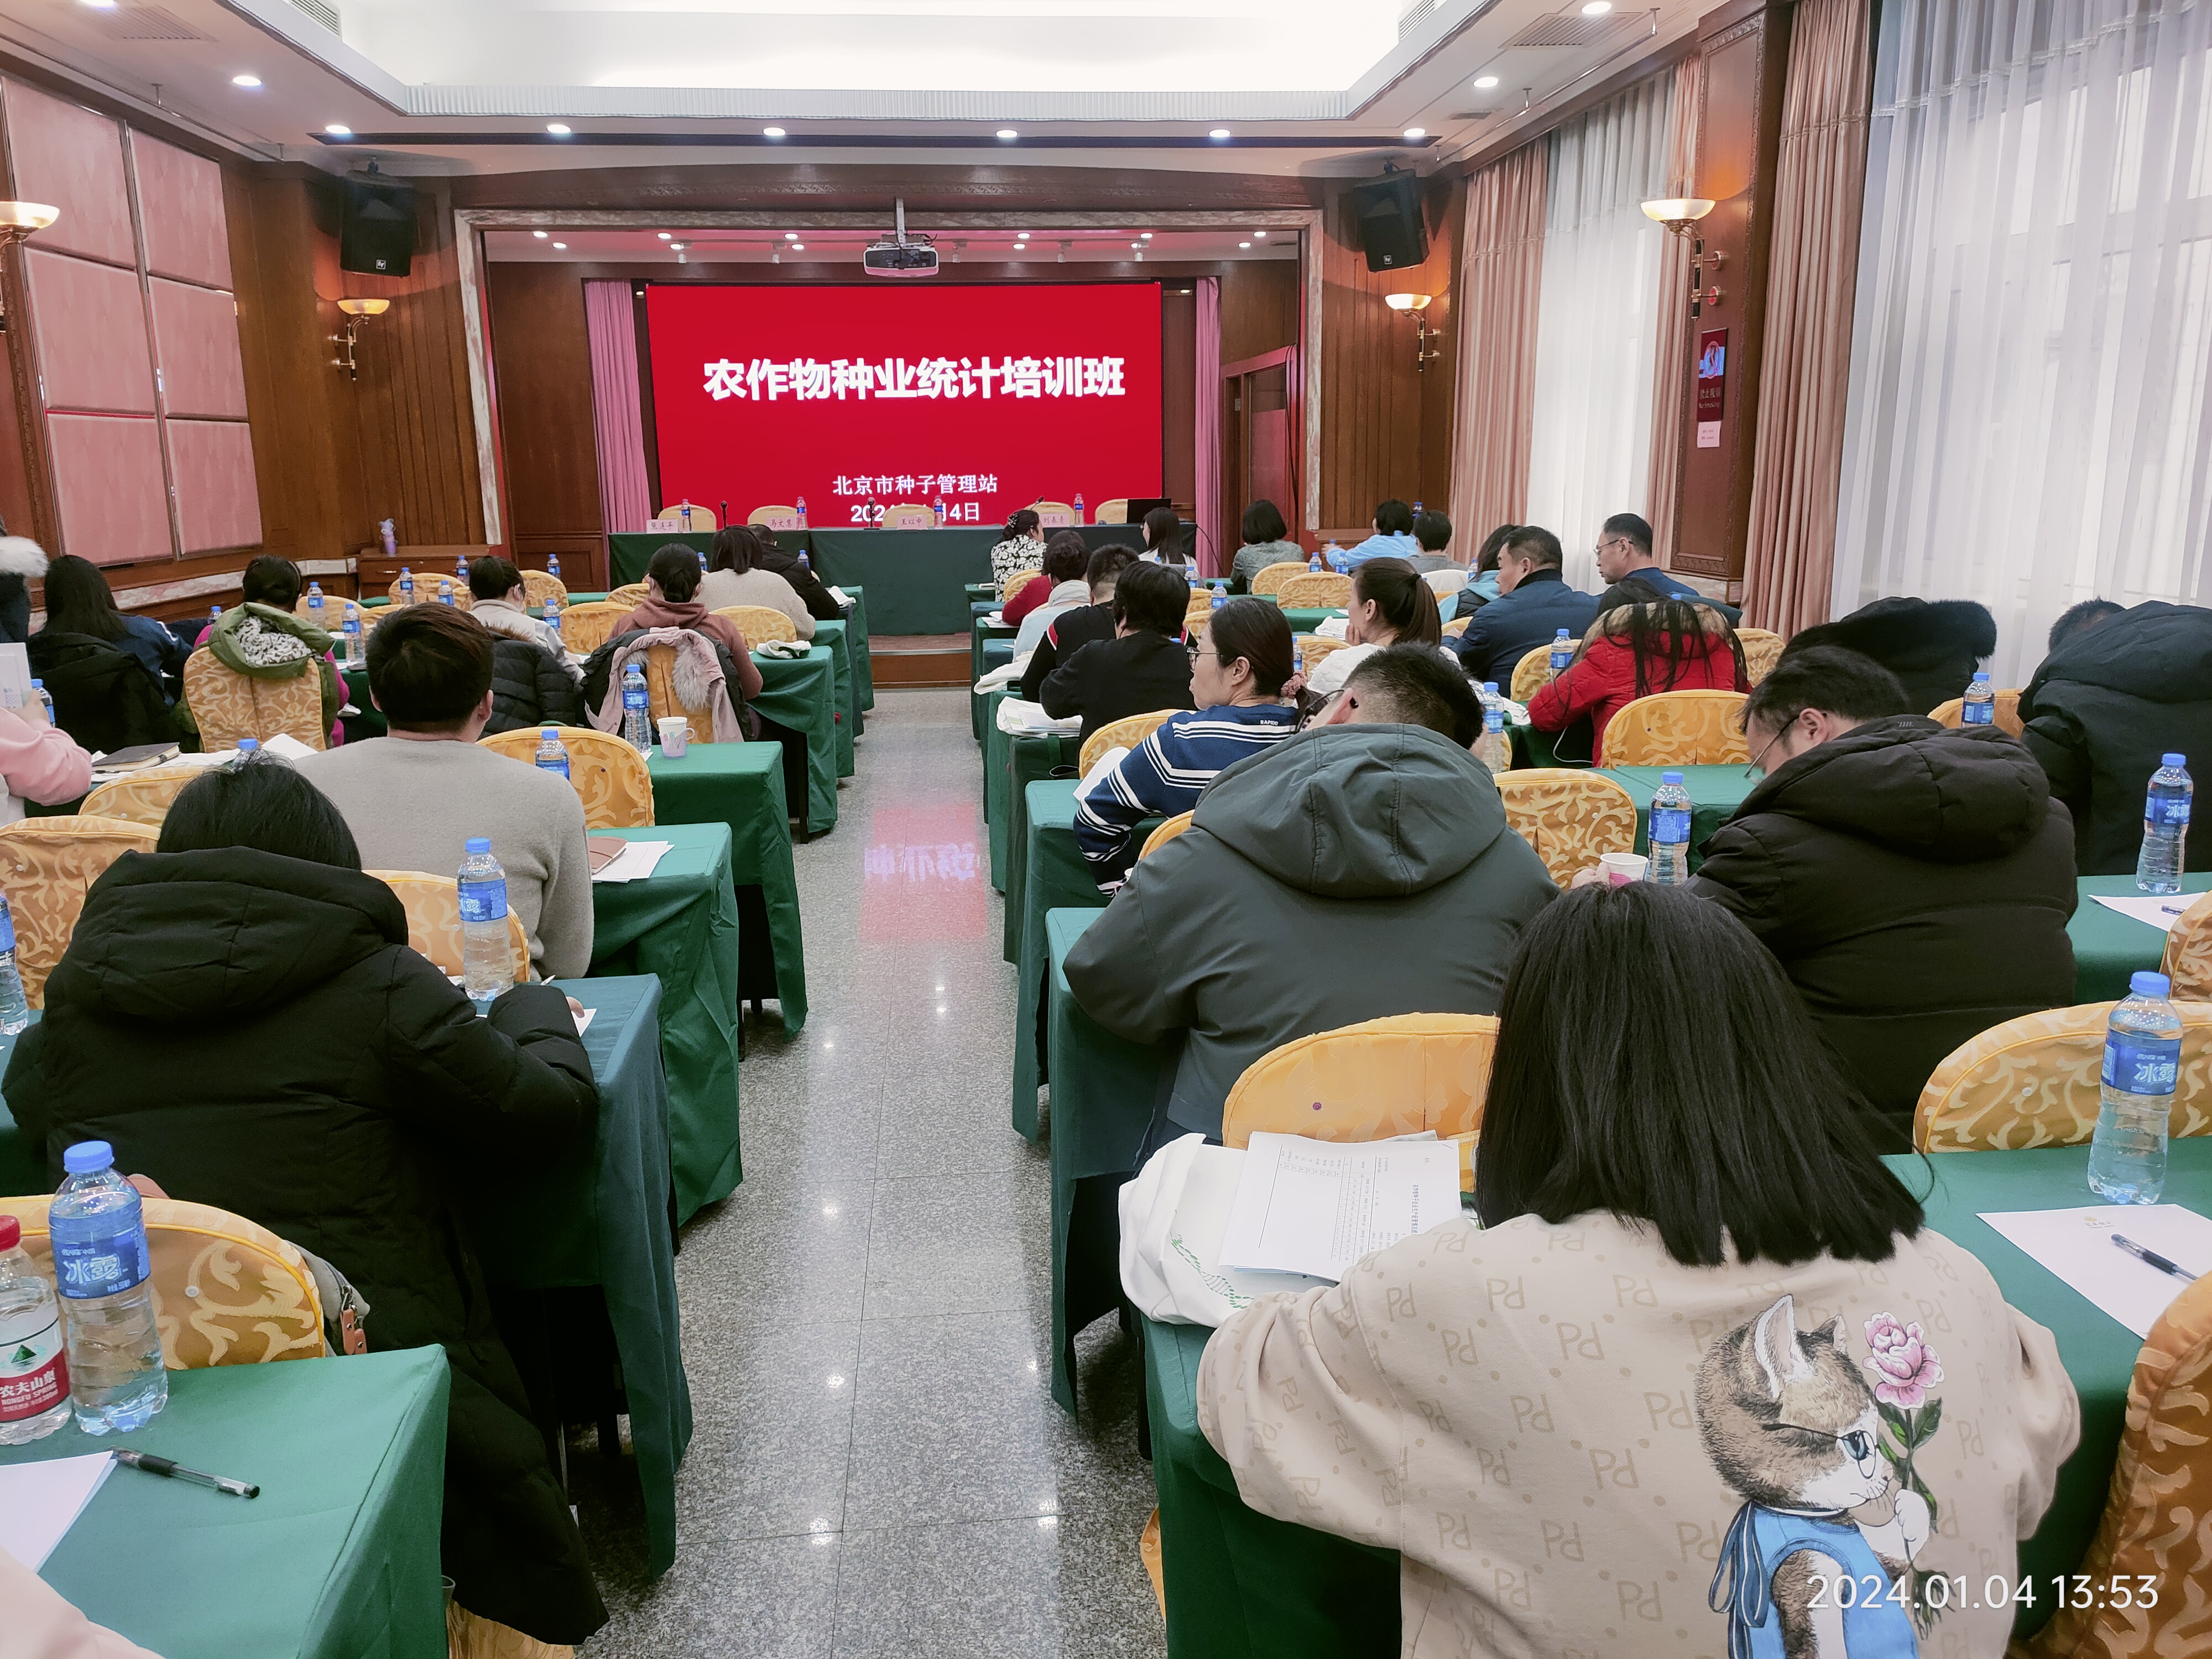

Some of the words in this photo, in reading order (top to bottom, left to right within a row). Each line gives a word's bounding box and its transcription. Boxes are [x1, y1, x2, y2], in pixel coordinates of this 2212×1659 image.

[703, 356, 1126, 401] 农作物种业统计培训班
[832, 473, 998, 495] 北京市种子管理站
[2133, 1062, 2176, 1084] 冰露
[62, 1253, 122, 1285] 冰露
[1386, 1282, 1417, 1322] Pd
[1486, 1275, 1526, 1312] Pd
[1613, 1274, 1658, 1308] Pd
[1441, 1328, 1479, 1366] Pd
[1556, 1322, 1605, 1360] Pd
[0, 1367, 56, 1398] 农夫山泉
[1509, 1394, 1555, 1433] Pd
[1643, 1390, 1695, 1431] Pd
[1588, 1448, 1639, 1490] Pd
[1436, 1511, 1472, 1550] Pd
[1541, 1519, 1584, 1562] Pd
[1616, 1579, 1662, 1622] Pd
